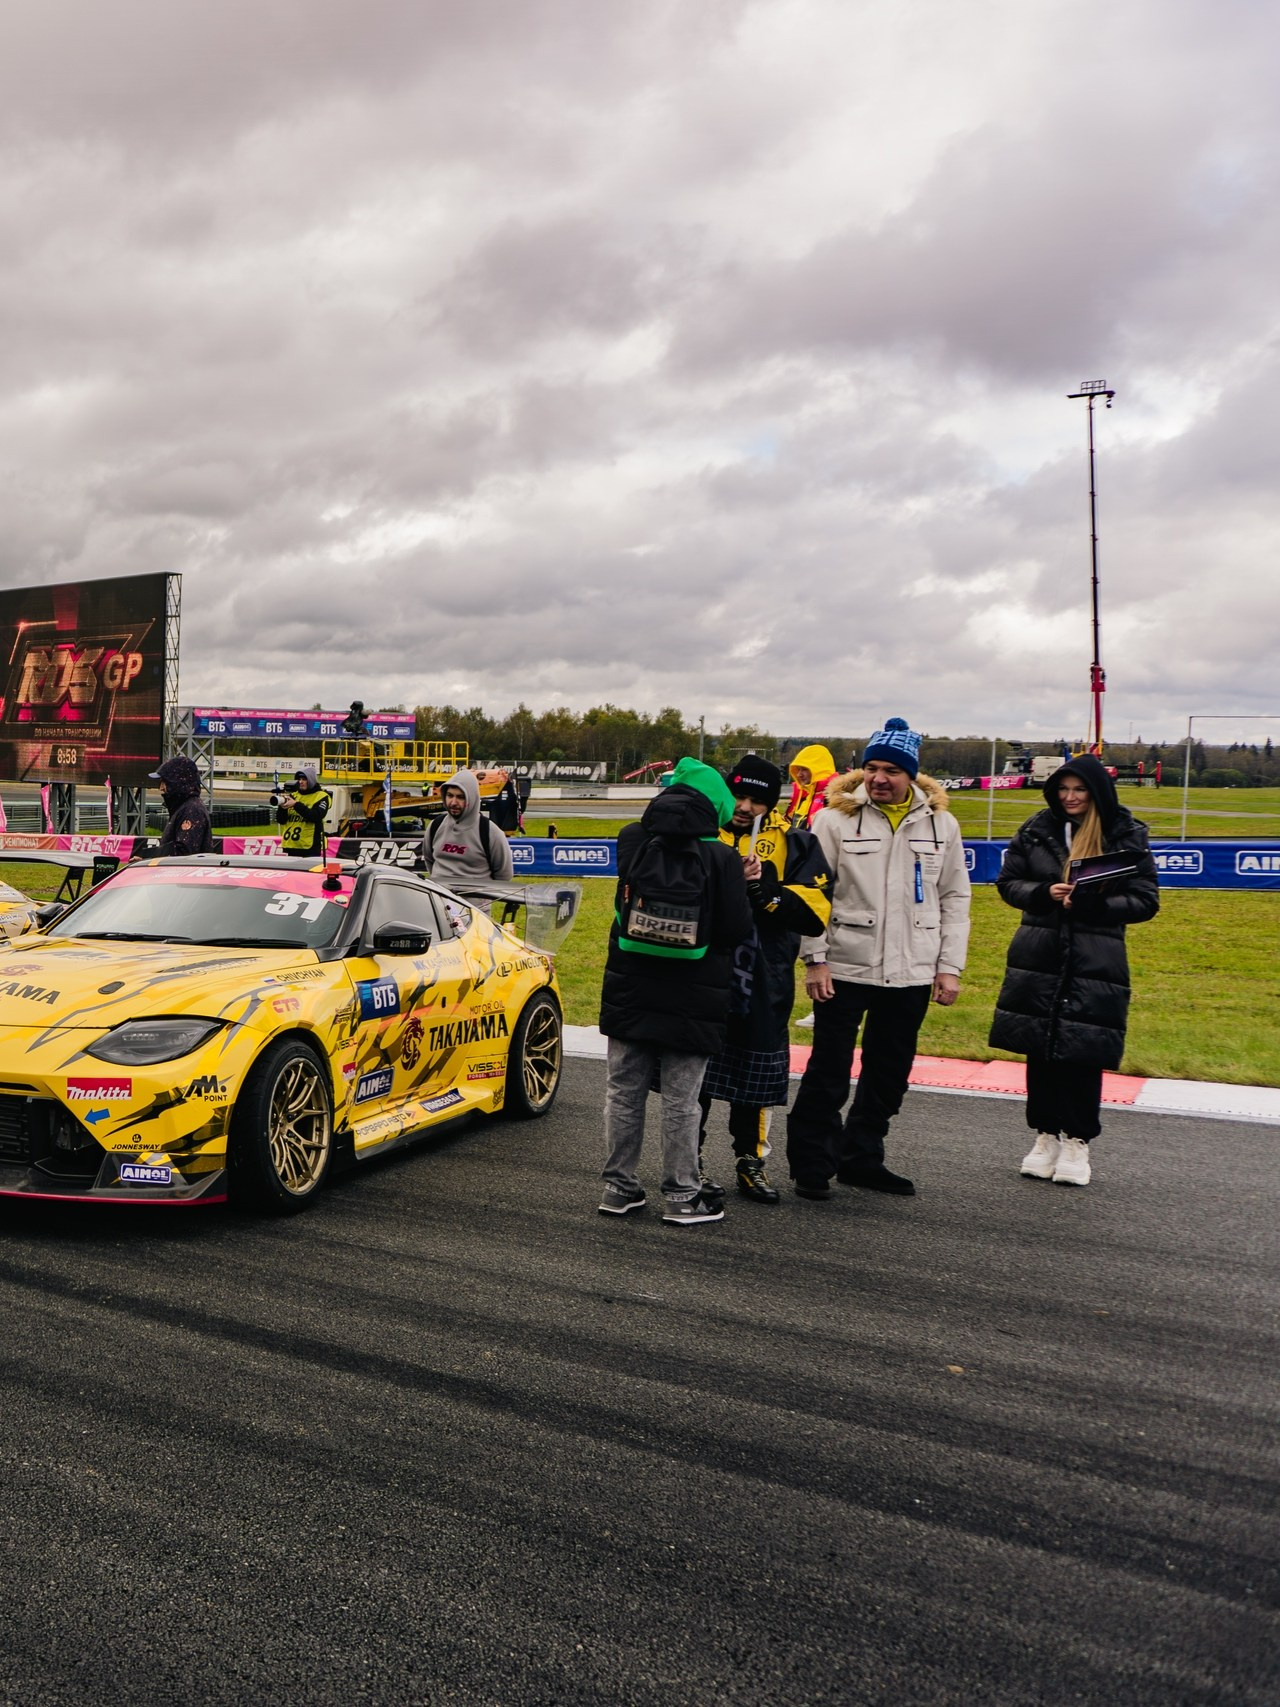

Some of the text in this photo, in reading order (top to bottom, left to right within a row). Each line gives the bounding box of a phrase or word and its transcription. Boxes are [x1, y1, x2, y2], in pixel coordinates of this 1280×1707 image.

[17, 648, 143, 704] RDS GP
[209, 721, 226, 732] ВТБ
[266, 722, 283, 733] ВТБ
[321, 724, 337, 734] ВТБ
[373, 725, 389, 736] ВТБ
[57, 748, 77, 764] 8:58
[283, 826, 302, 842] 68
[358, 841, 422, 867] RDS
[442, 843, 468, 855] RDS
[556, 849, 607, 862] AIMOL
[759, 843, 771, 855] 31
[1154, 855, 1198, 870] MOL
[265, 892, 329, 923] 31
[636, 914, 693, 934] BRIDE
[276, 968, 326, 983] CHIVCHYAN
[372, 985, 396, 1010] ВТБ
[470, 1000, 505, 1015] MOTOR OIL
[429, 1013, 509, 1051] TAKAYAMA
[468, 1061, 505, 1072] VISSOL
[358, 1074, 391, 1098] AIMOL
[204, 1094, 228, 1102] POINT
[123, 1167, 169, 1180] AIMOL
